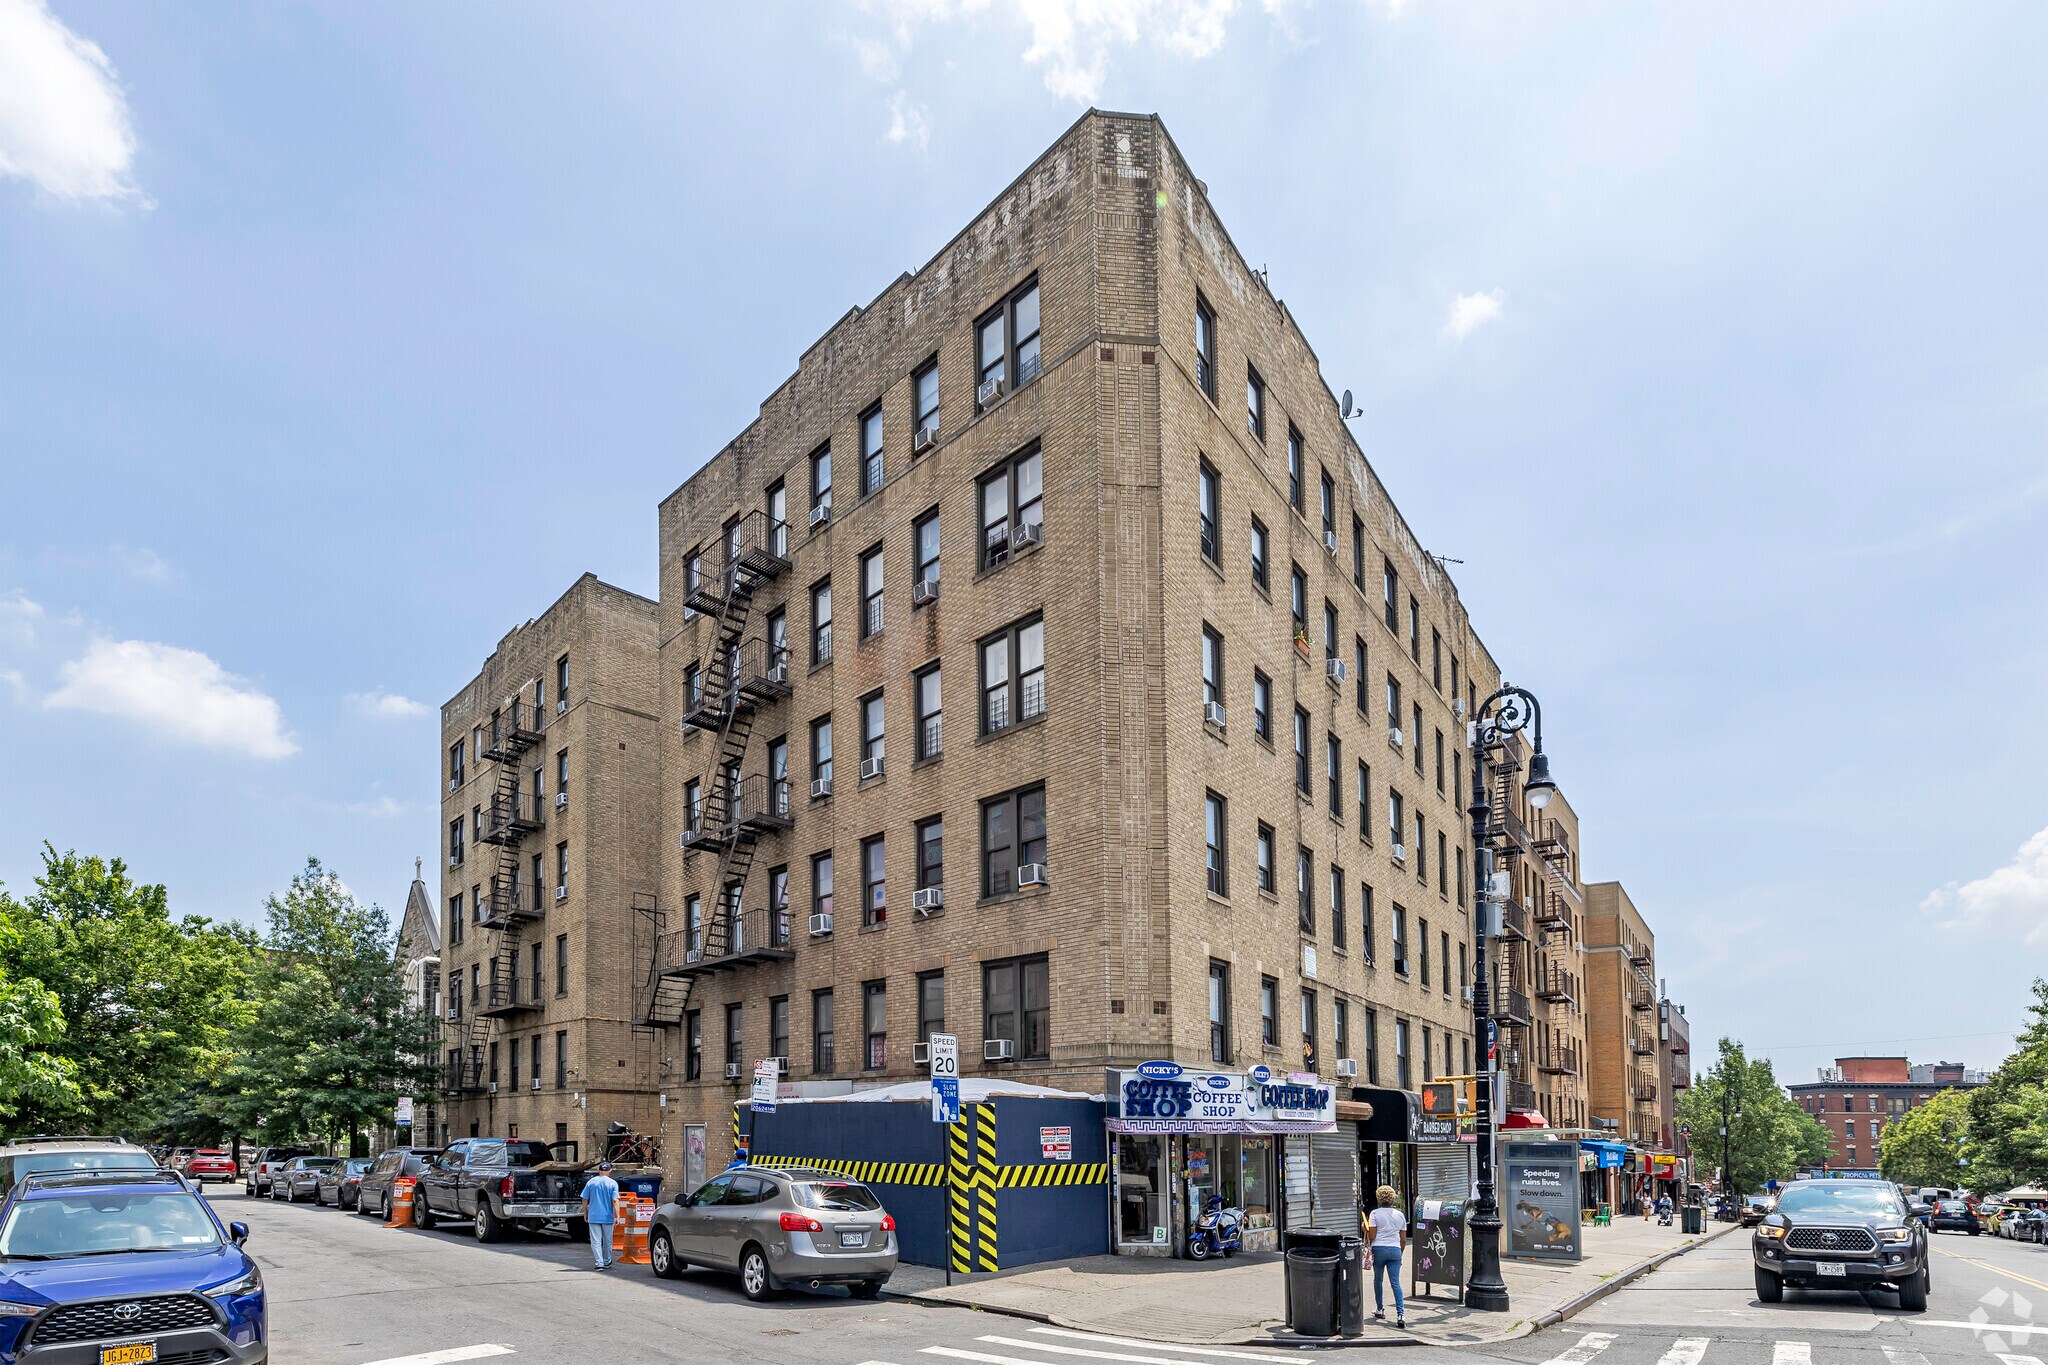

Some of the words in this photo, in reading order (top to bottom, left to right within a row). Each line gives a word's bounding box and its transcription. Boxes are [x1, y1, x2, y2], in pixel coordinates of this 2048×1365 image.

[933, 1038, 955, 1046] SPEED
[935, 1057, 955, 1073] 20
[1142, 1066, 1179, 1074] NICKY'S
[755, 1077, 760, 1085] 2
[942, 1083, 957, 1091] SLOW
[1126, 1080, 1192, 1099] COFFEE
[1193, 1092, 1242, 1104] COFFEE
[1261, 1085, 1305, 1108] COFFEE
[1305, 1087, 1330, 1110] SHOP
[1126, 1099, 1192, 1117] SHOP
[1202, 1105, 1236, 1117] SHOP
[1423, 1121, 1440, 1134] BARBER
[1440, 1121, 1452, 1134] SHOP
[1523, 1169, 1560, 1179] Speeding
[1521, 1178, 1540, 1186] ruins
[1541, 1178, 1562, 1186] lives.
[1520, 1189, 1538, 1197] Slow
[1540, 1189, 1564, 1198] down.
[1156, 1229, 1164, 1239] B
